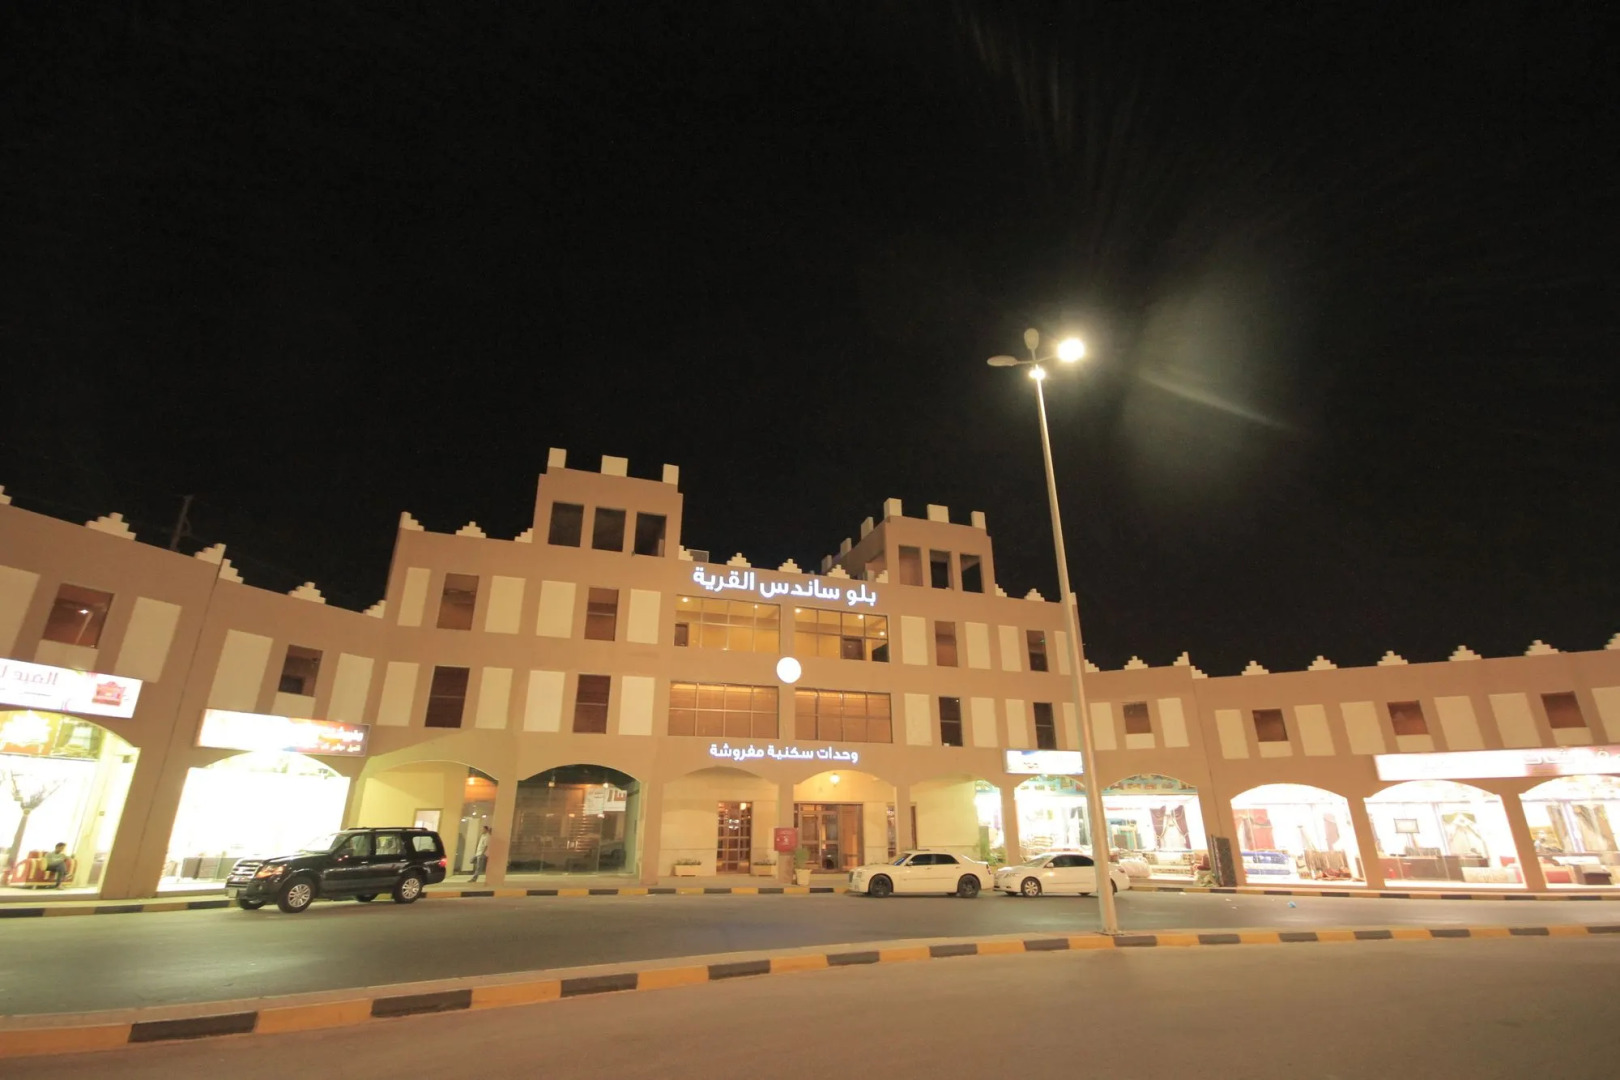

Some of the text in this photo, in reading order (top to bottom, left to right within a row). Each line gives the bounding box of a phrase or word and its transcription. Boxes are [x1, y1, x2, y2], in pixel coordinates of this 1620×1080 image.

[693, 567, 877, 607] بلو ساندس القرية
[709, 743, 859, 764] وحدات سكنية مفروشة
